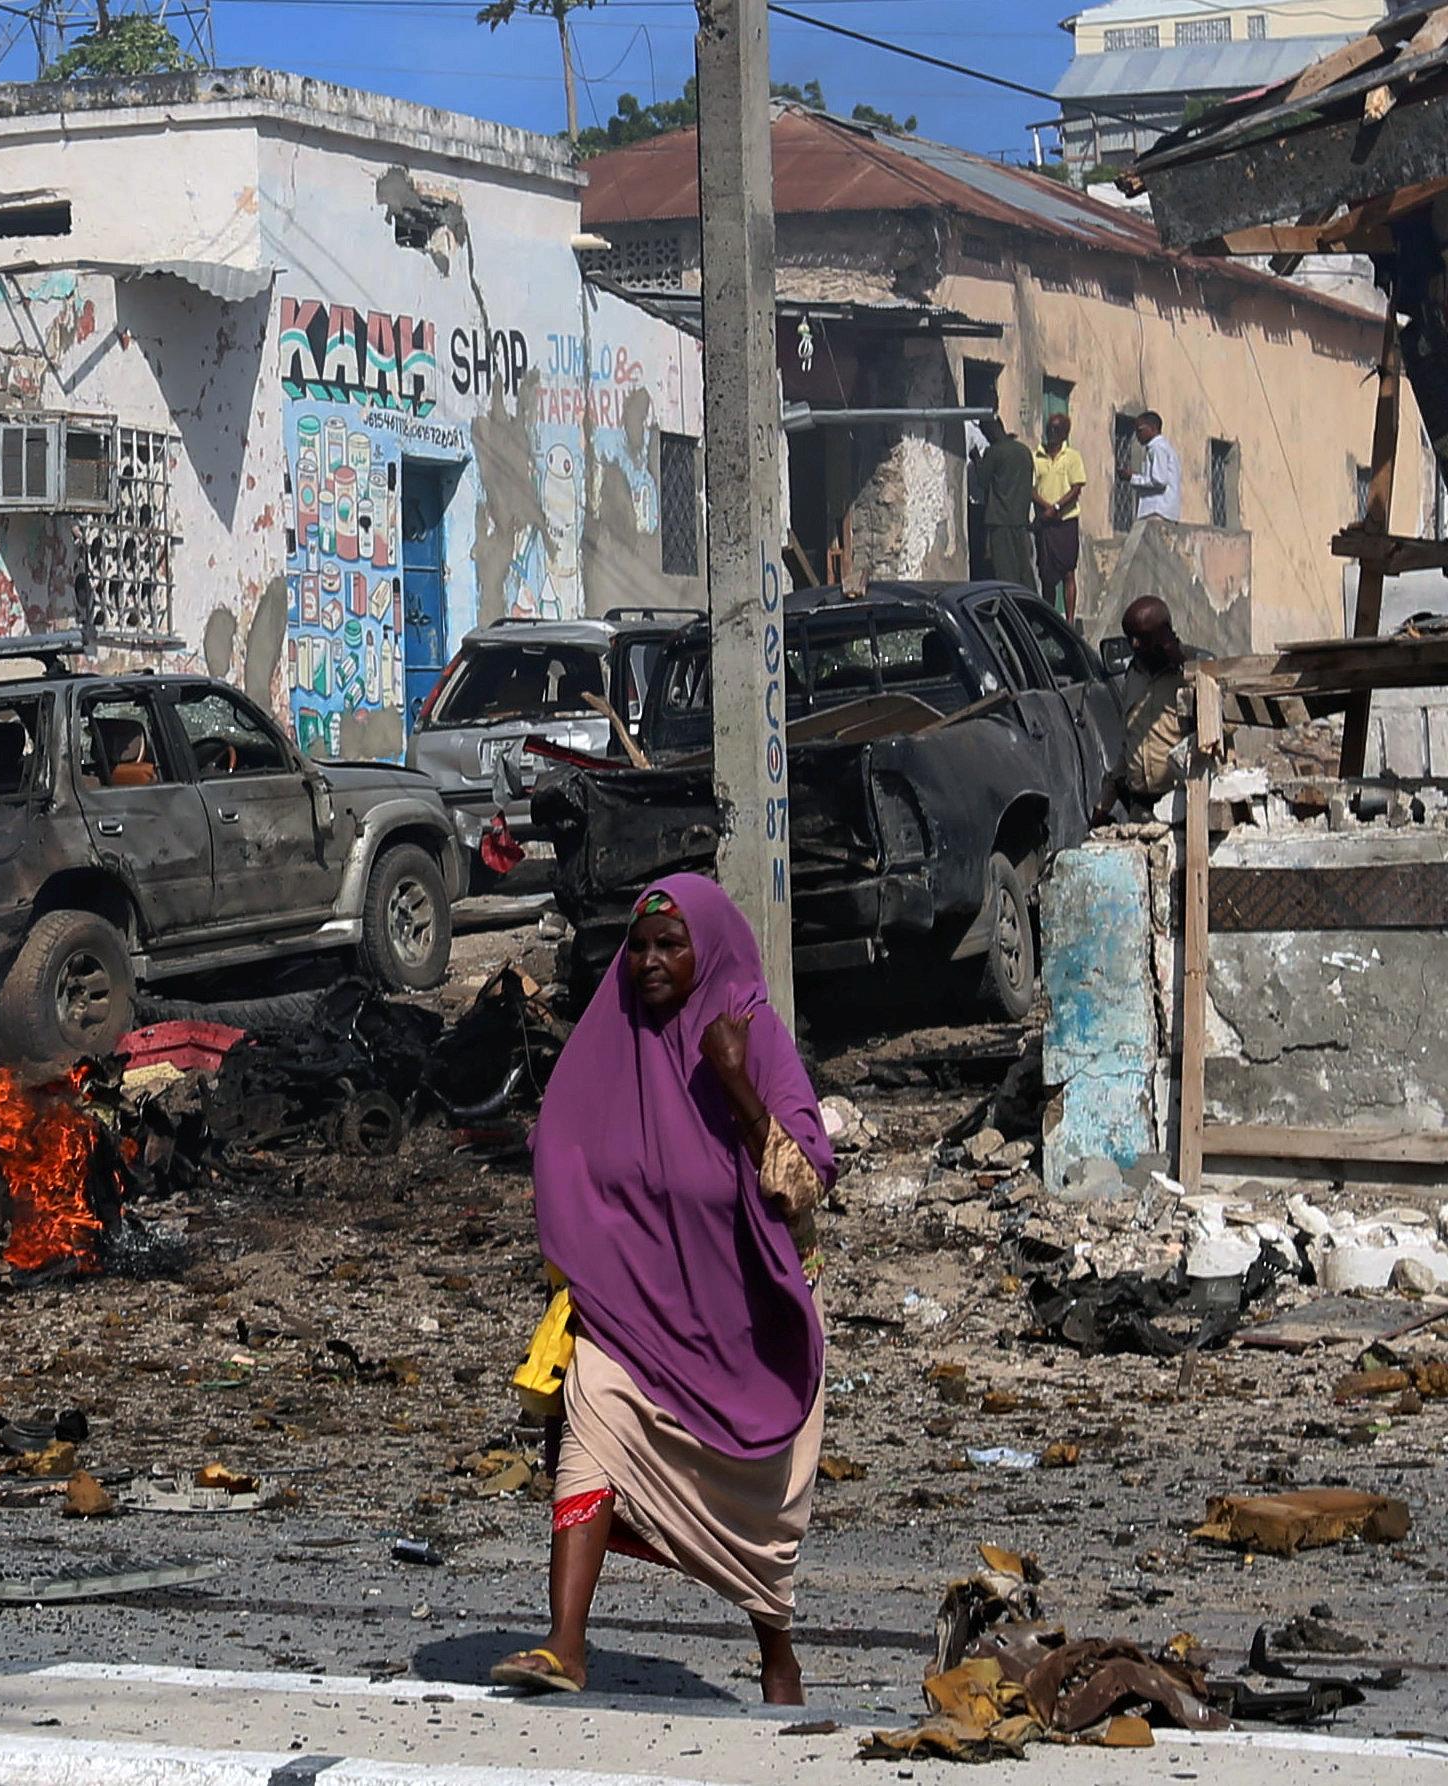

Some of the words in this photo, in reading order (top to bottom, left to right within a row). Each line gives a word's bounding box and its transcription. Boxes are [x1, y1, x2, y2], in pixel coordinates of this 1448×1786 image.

[280, 296, 437, 418] KAAH
[451, 327, 528, 397] SHOP
[759, 539, 784, 785] beco
[765, 796, 788, 843] 87
[772, 857, 786, 905] M
